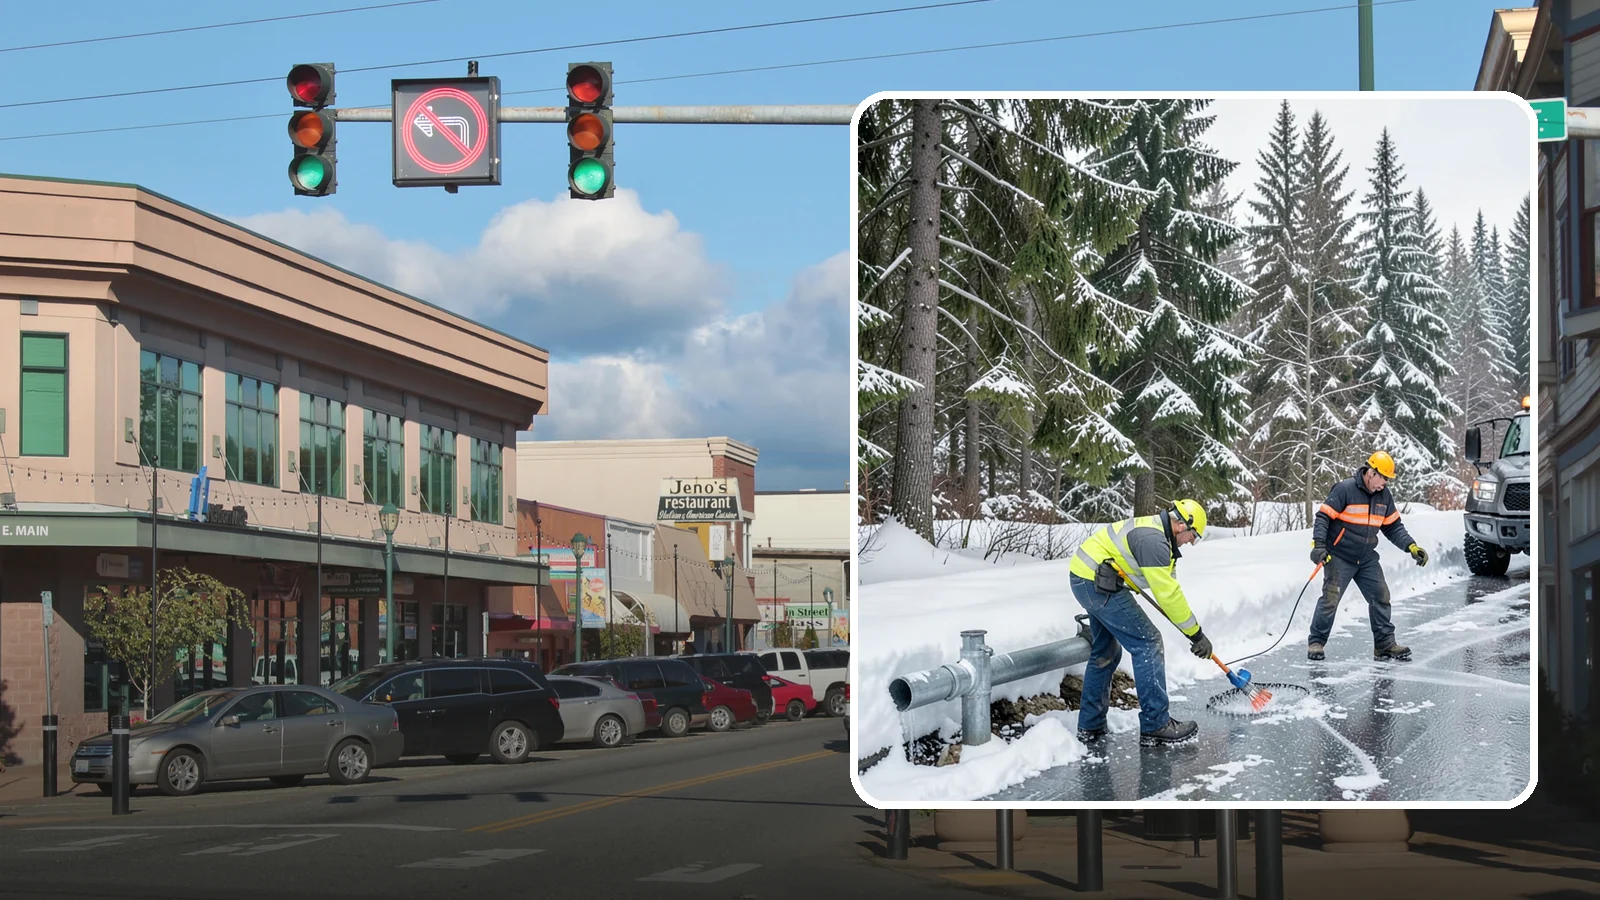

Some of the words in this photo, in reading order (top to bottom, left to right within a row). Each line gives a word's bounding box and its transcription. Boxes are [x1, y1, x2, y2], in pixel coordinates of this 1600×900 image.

[669, 480, 727, 495] Jeno's
[665, 496, 731, 509] restaurant
[658, 509, 681, 519] Italian
[686, 509, 714, 519] American
[715, 509, 738, 519] Cuisine
[2, 525, 13, 536] E.
[15, 525, 49, 536] MAIN
[797, 607, 828, 617] Street
